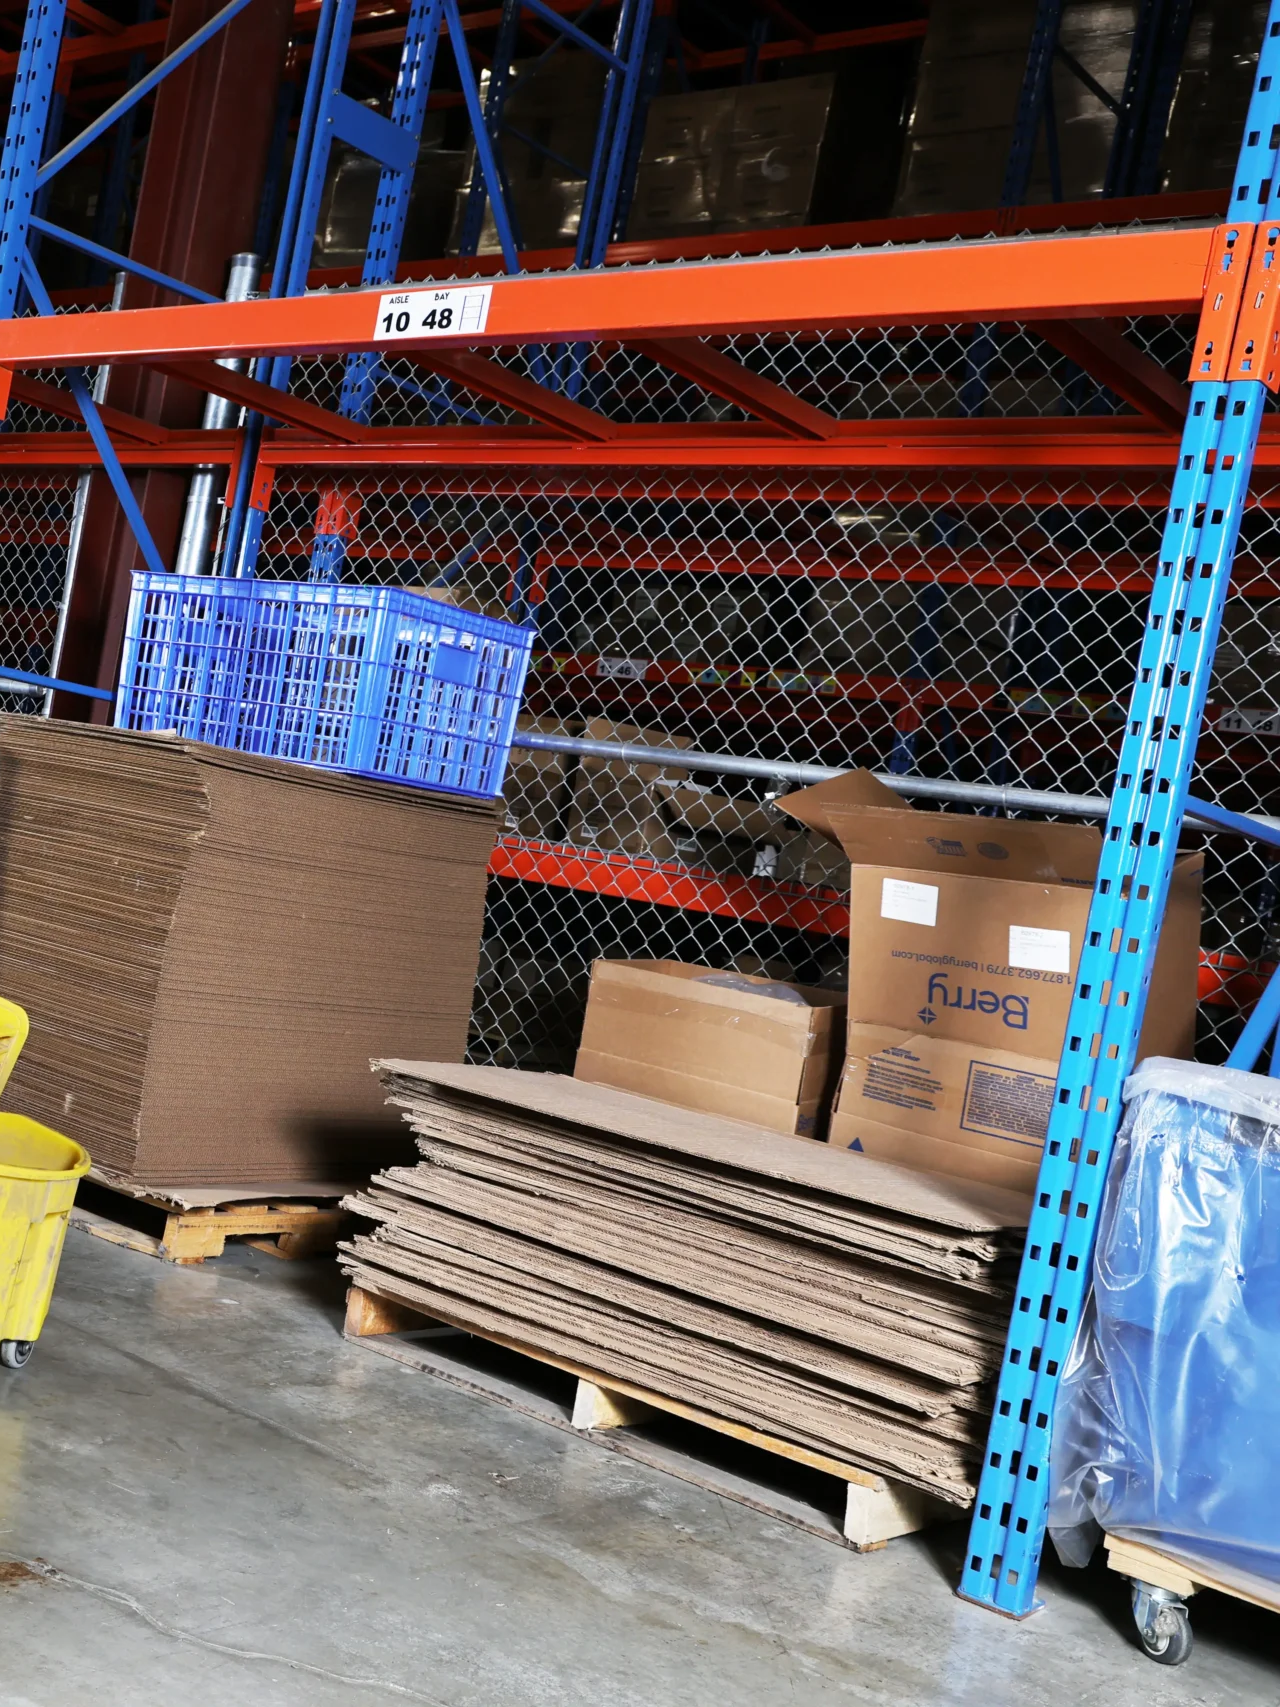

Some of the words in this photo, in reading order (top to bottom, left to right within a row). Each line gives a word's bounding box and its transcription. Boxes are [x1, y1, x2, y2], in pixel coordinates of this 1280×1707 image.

[389, 295, 410, 304] AISLE
[434, 292, 450, 301] BAY
[382, 311, 410, 333] 10
[421, 308, 453, 329] 48
[617, 665, 631, 675] 46
[1223, 717, 1242, 729] 11
[891, 950, 978, 971] berryglobal.com
[986, 966, 1072, 985] 1.877.662.3779
[928, 973, 1029, 1030] Berry
